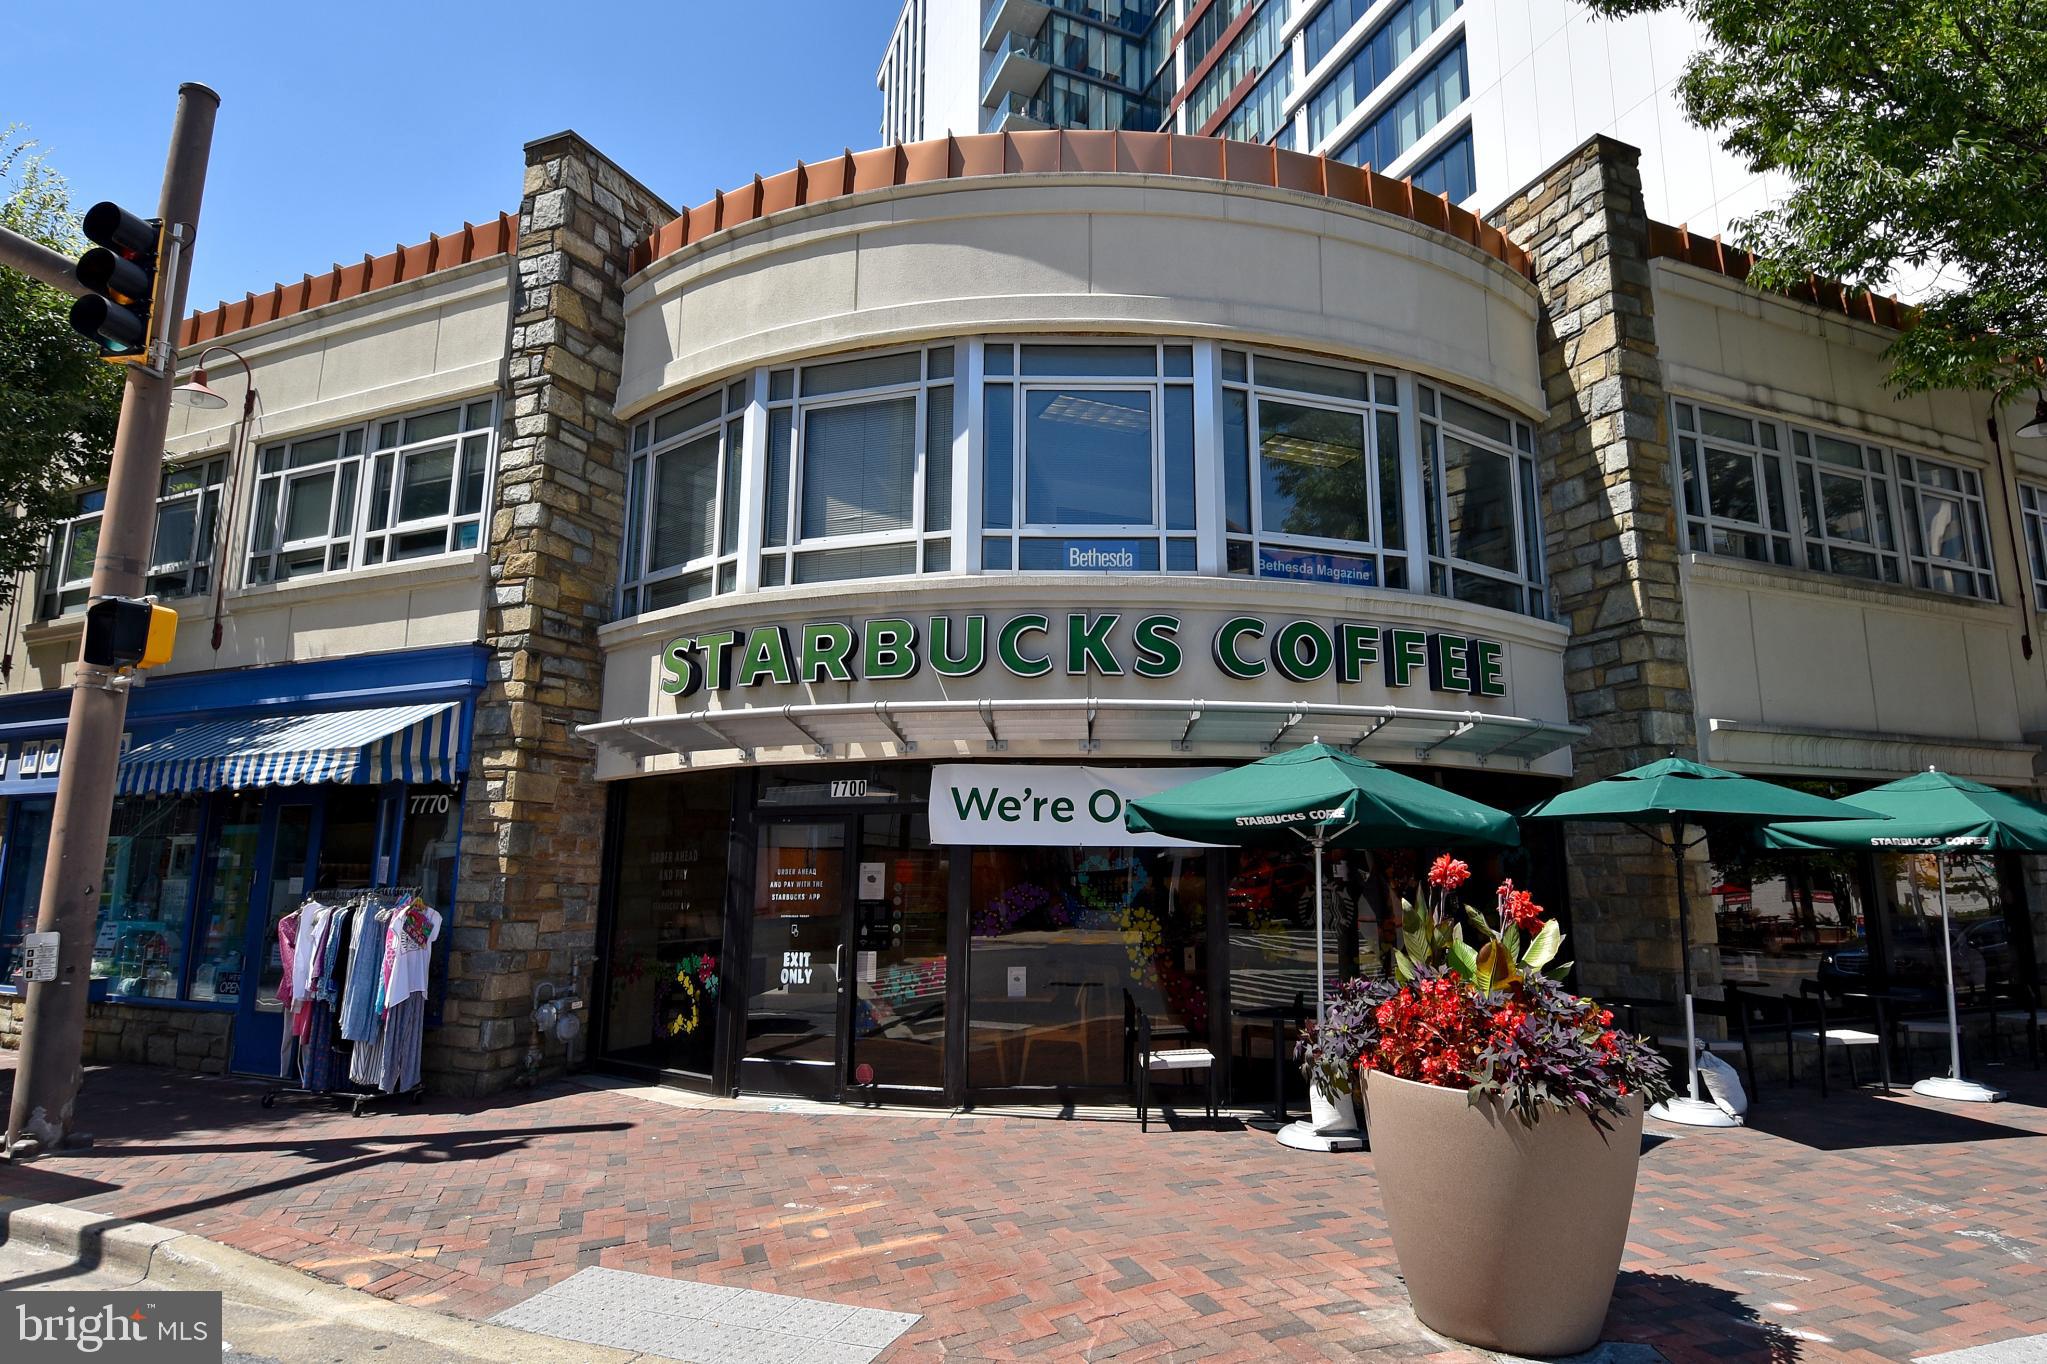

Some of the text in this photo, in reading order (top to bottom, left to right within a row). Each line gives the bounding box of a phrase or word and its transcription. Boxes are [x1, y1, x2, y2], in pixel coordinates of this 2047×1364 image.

[1069, 547, 1133, 567] Bethesda
[1259, 558, 1370, 580] Bethesda Magazine
[660, 613, 1507, 698] STARBUCKS COFFEE
[832, 780, 866, 797] 7700
[410, 794, 449, 815] 7770
[1088, 788, 1131, 824] O
[1235, 812, 1306, 827] STARBUCKS
[1871, 836, 1989, 846] STARBUCKS COFFEE
[808, 893, 821, 901] APP
[783, 951, 812, 968] EXIT
[780, 968, 813, 985] ONLY
